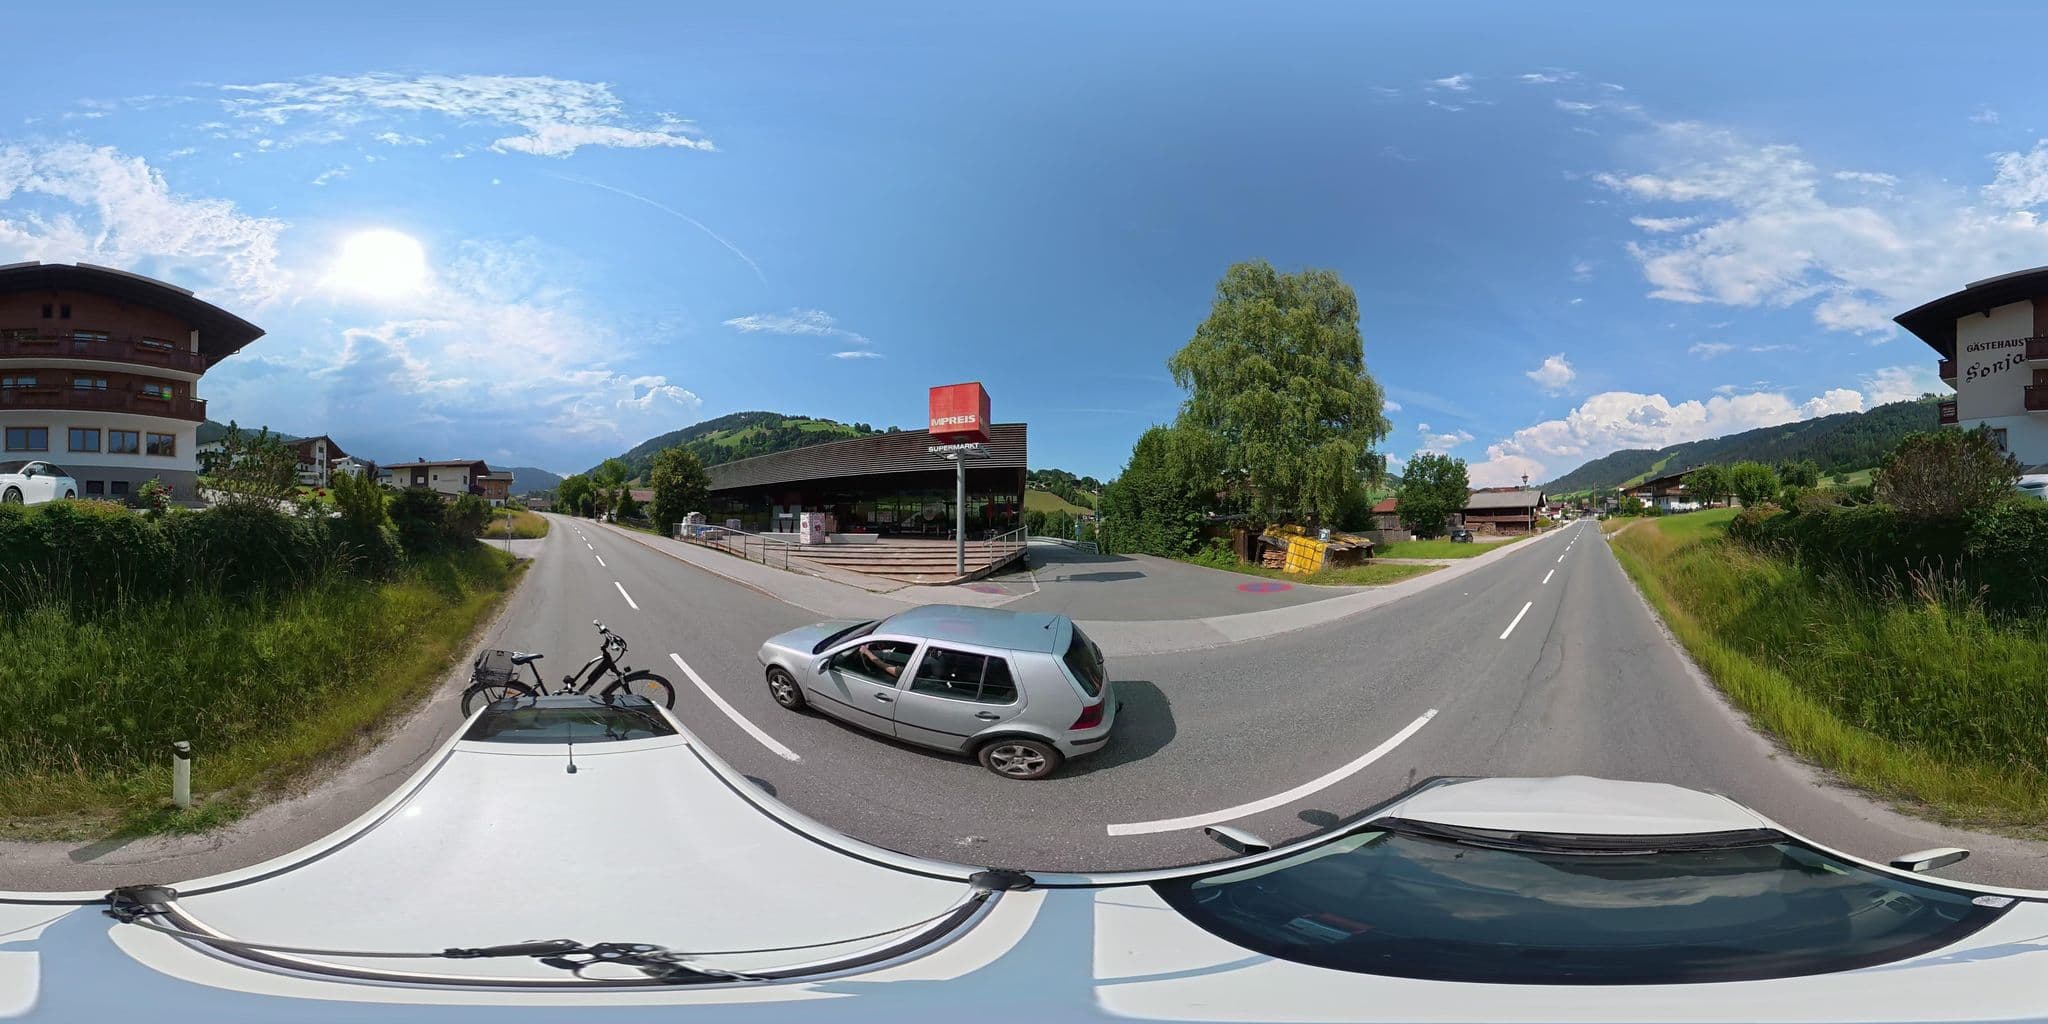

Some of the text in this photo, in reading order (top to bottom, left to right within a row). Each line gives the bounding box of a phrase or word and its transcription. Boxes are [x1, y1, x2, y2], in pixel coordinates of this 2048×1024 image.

[1966, 338, 2024, 353] GÄSTEHAUS
[1966, 353, 2027, 383] Sonja
[931, 414, 976, 427] MPREIS
[928, 442, 980, 453] SUPERMARKT
